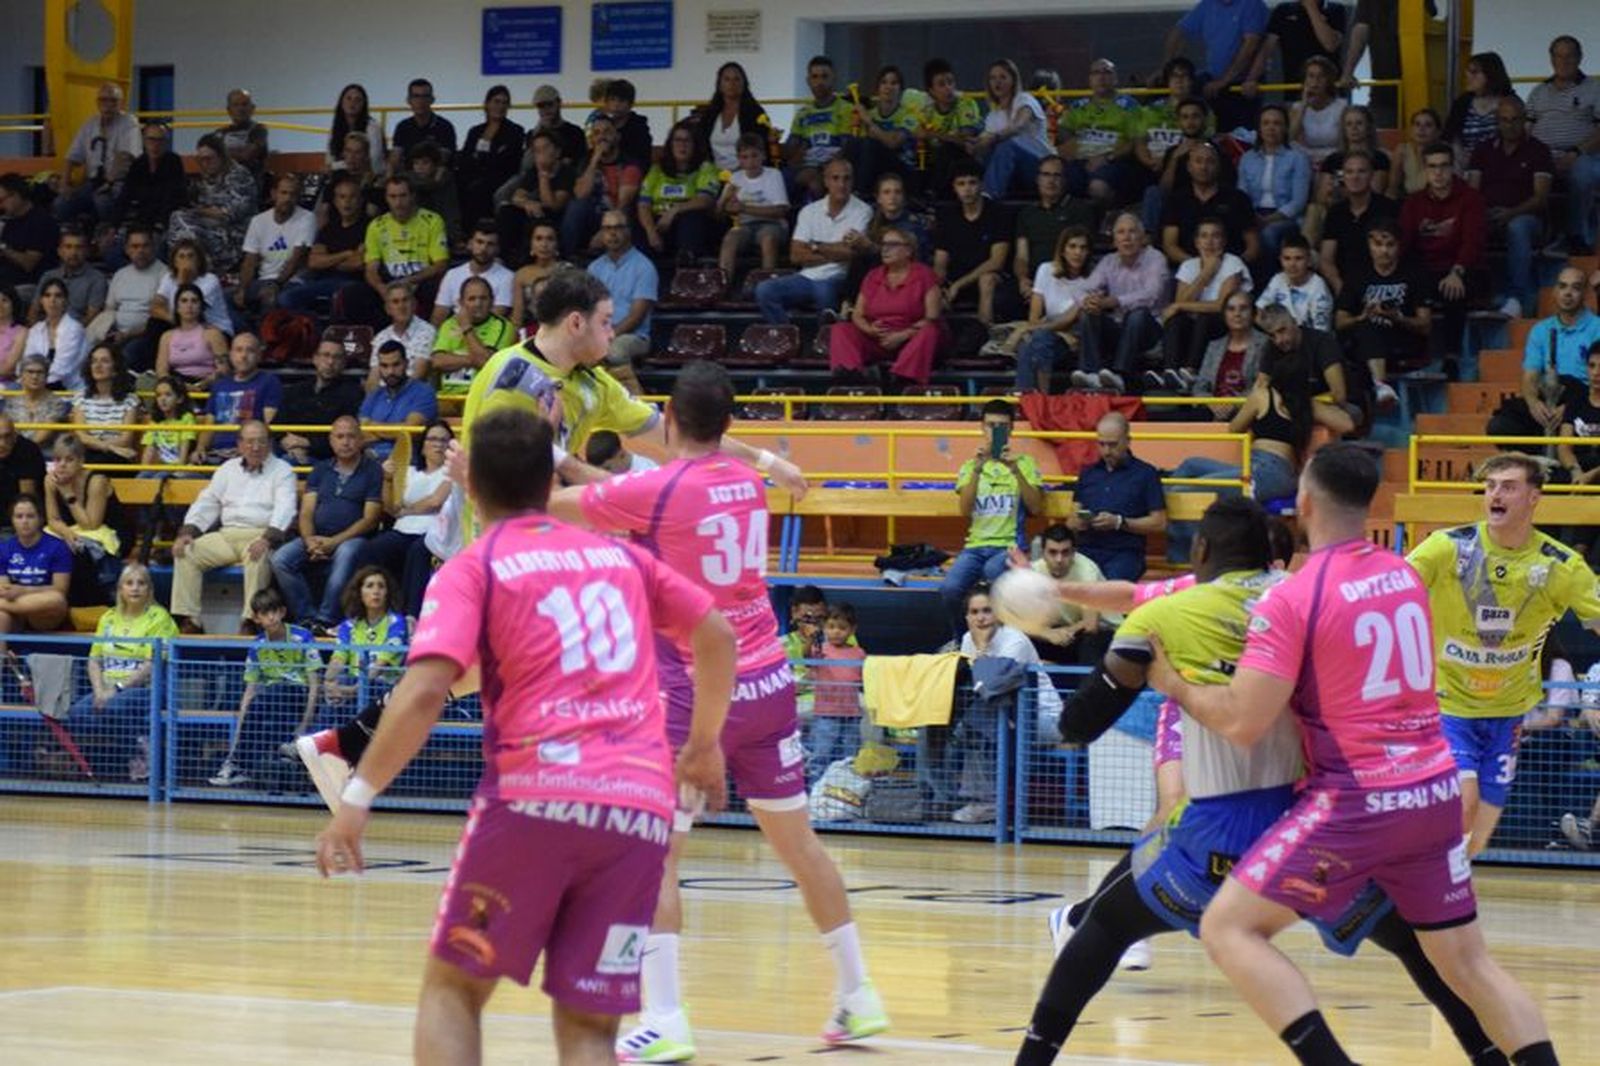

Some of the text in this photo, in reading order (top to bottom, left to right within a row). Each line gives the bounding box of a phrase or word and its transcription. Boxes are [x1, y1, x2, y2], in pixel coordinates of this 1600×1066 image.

[491, 549, 583, 581] ALBERTO
[696, 509, 767, 586] 34
[1340, 570, 1418, 603] ORTEGA
[536, 581, 637, 676] 10
[1354, 601, 1434, 702] 20
